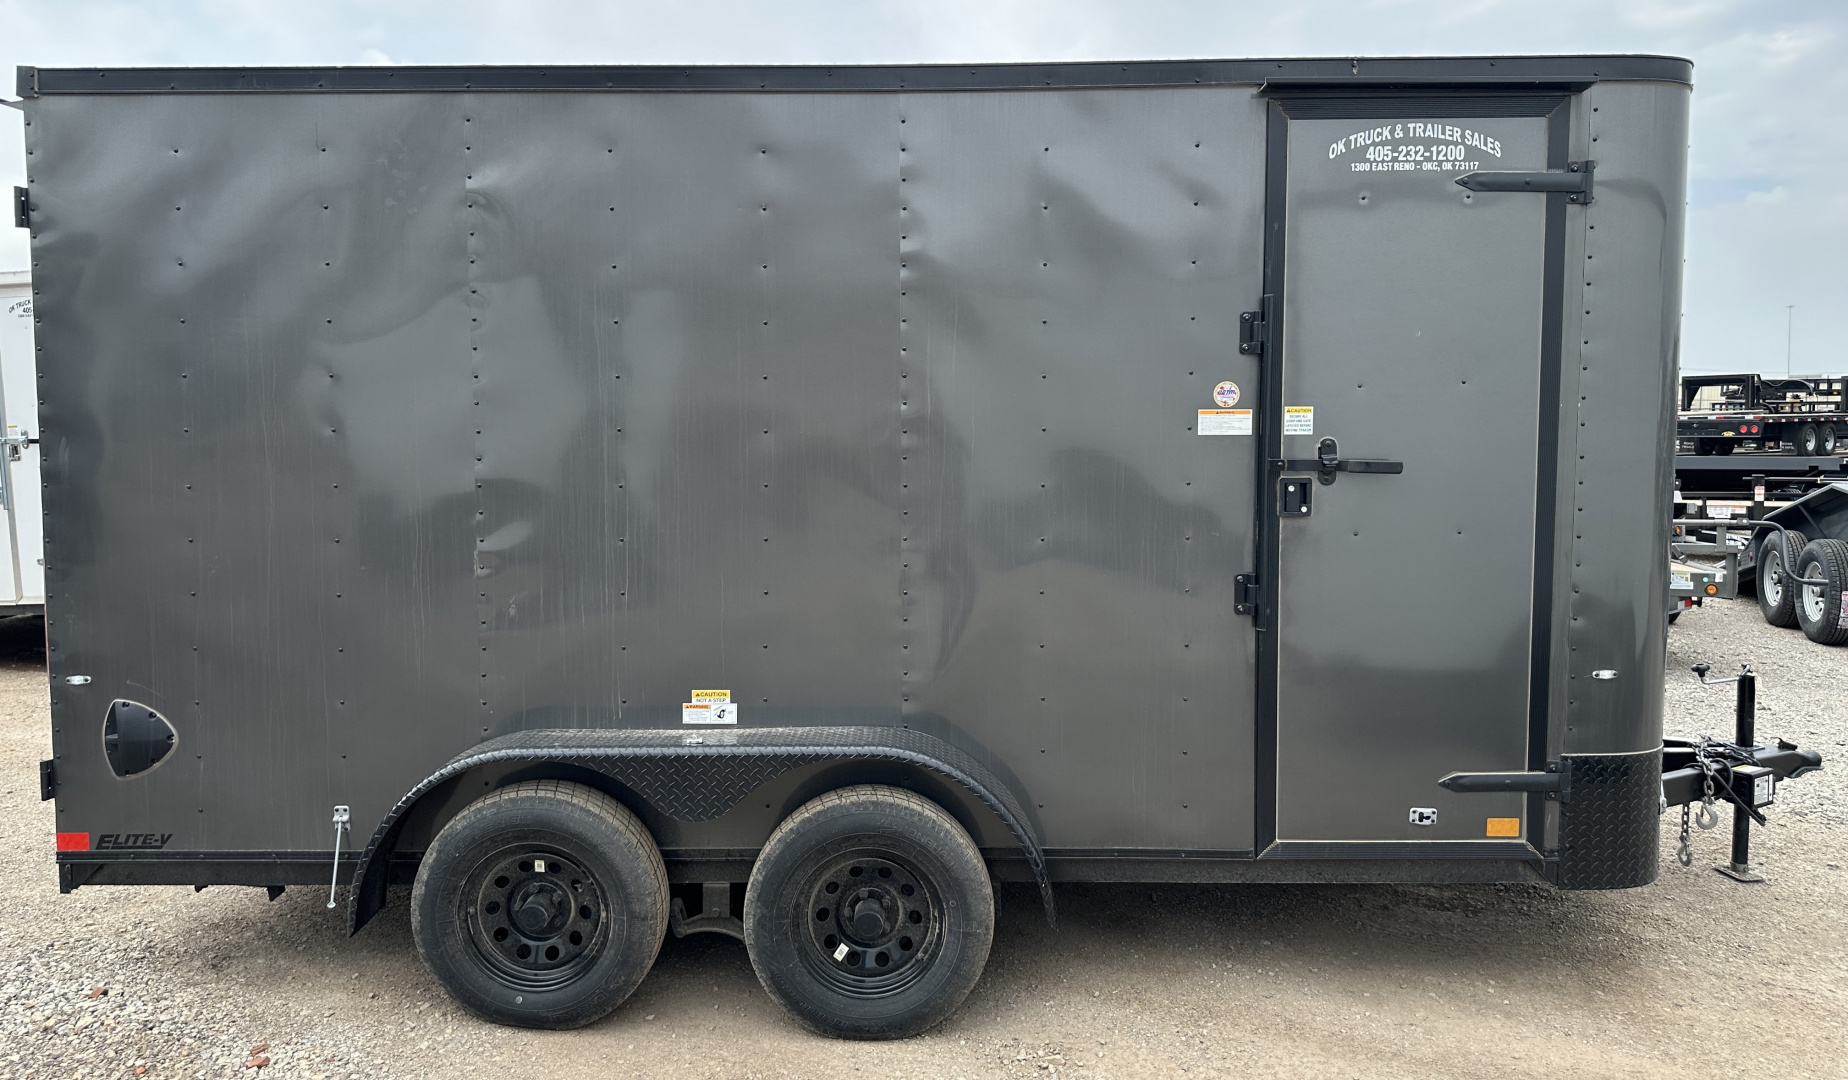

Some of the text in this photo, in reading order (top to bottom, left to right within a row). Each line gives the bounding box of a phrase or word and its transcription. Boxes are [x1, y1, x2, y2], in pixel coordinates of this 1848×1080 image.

[1328, 122, 1502, 160] OK TRUCK & TRAILER SALES
[1365, 144, 1465, 161] 405-232-1200
[1350, 162, 1371, 172] 1300
[1371, 162, 1394, 171] EAST
[1394, 162, 1415, 171] RENO
[1422, 161, 1440, 172] OKC,
[1442, 161, 1453, 170] OK
[1454, 161, 1479, 171] 73117
[95, 833, 174, 850] ELITE-V
